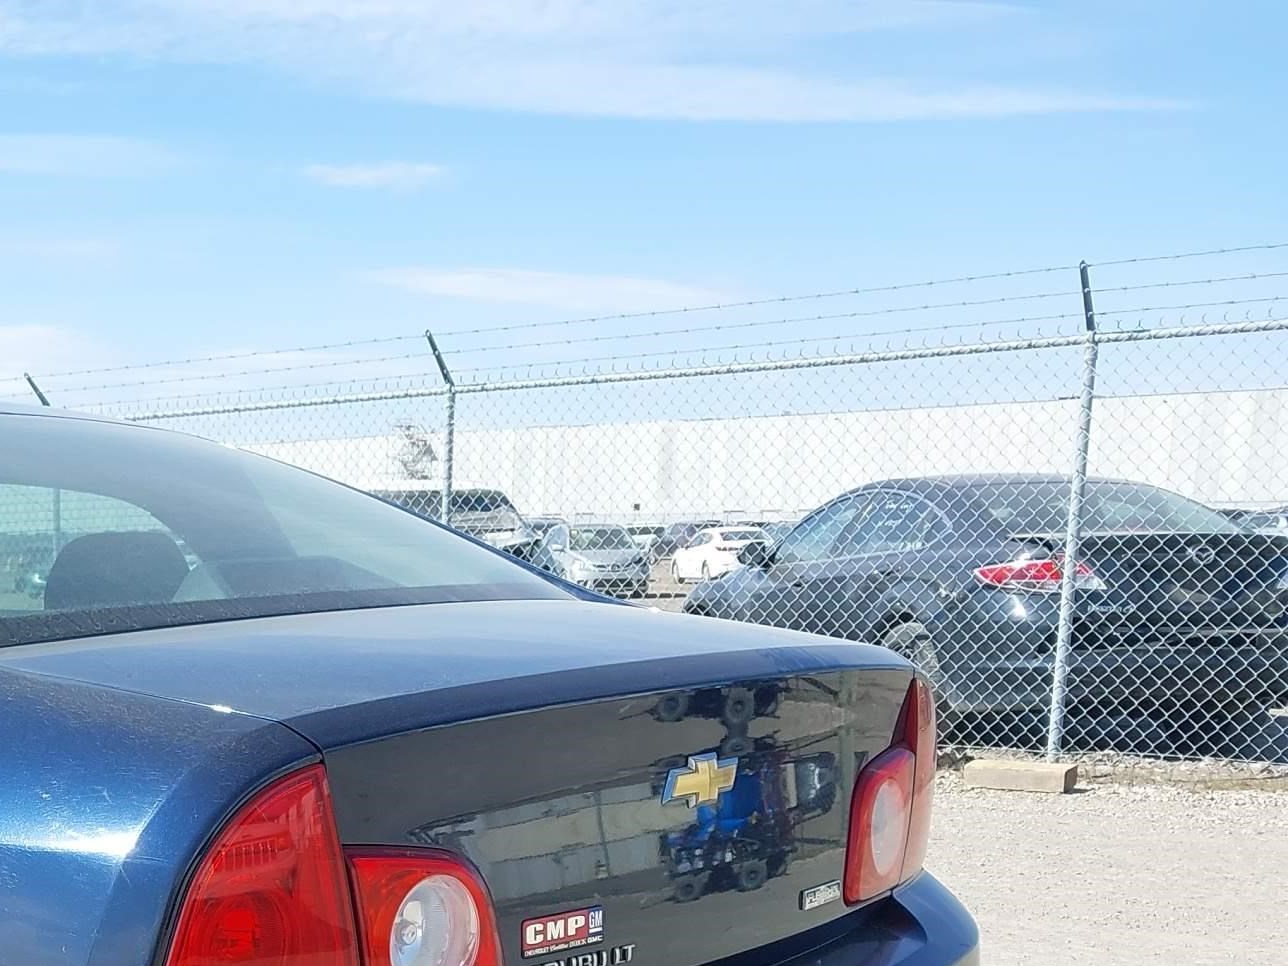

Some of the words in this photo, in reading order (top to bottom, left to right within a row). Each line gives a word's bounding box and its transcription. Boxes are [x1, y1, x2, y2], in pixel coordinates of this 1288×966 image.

[588, 910, 603, 929] GM
[525, 915, 586, 945] CMP
[587, 935, 604, 944] GMC
[614, 944, 636, 966] LT
